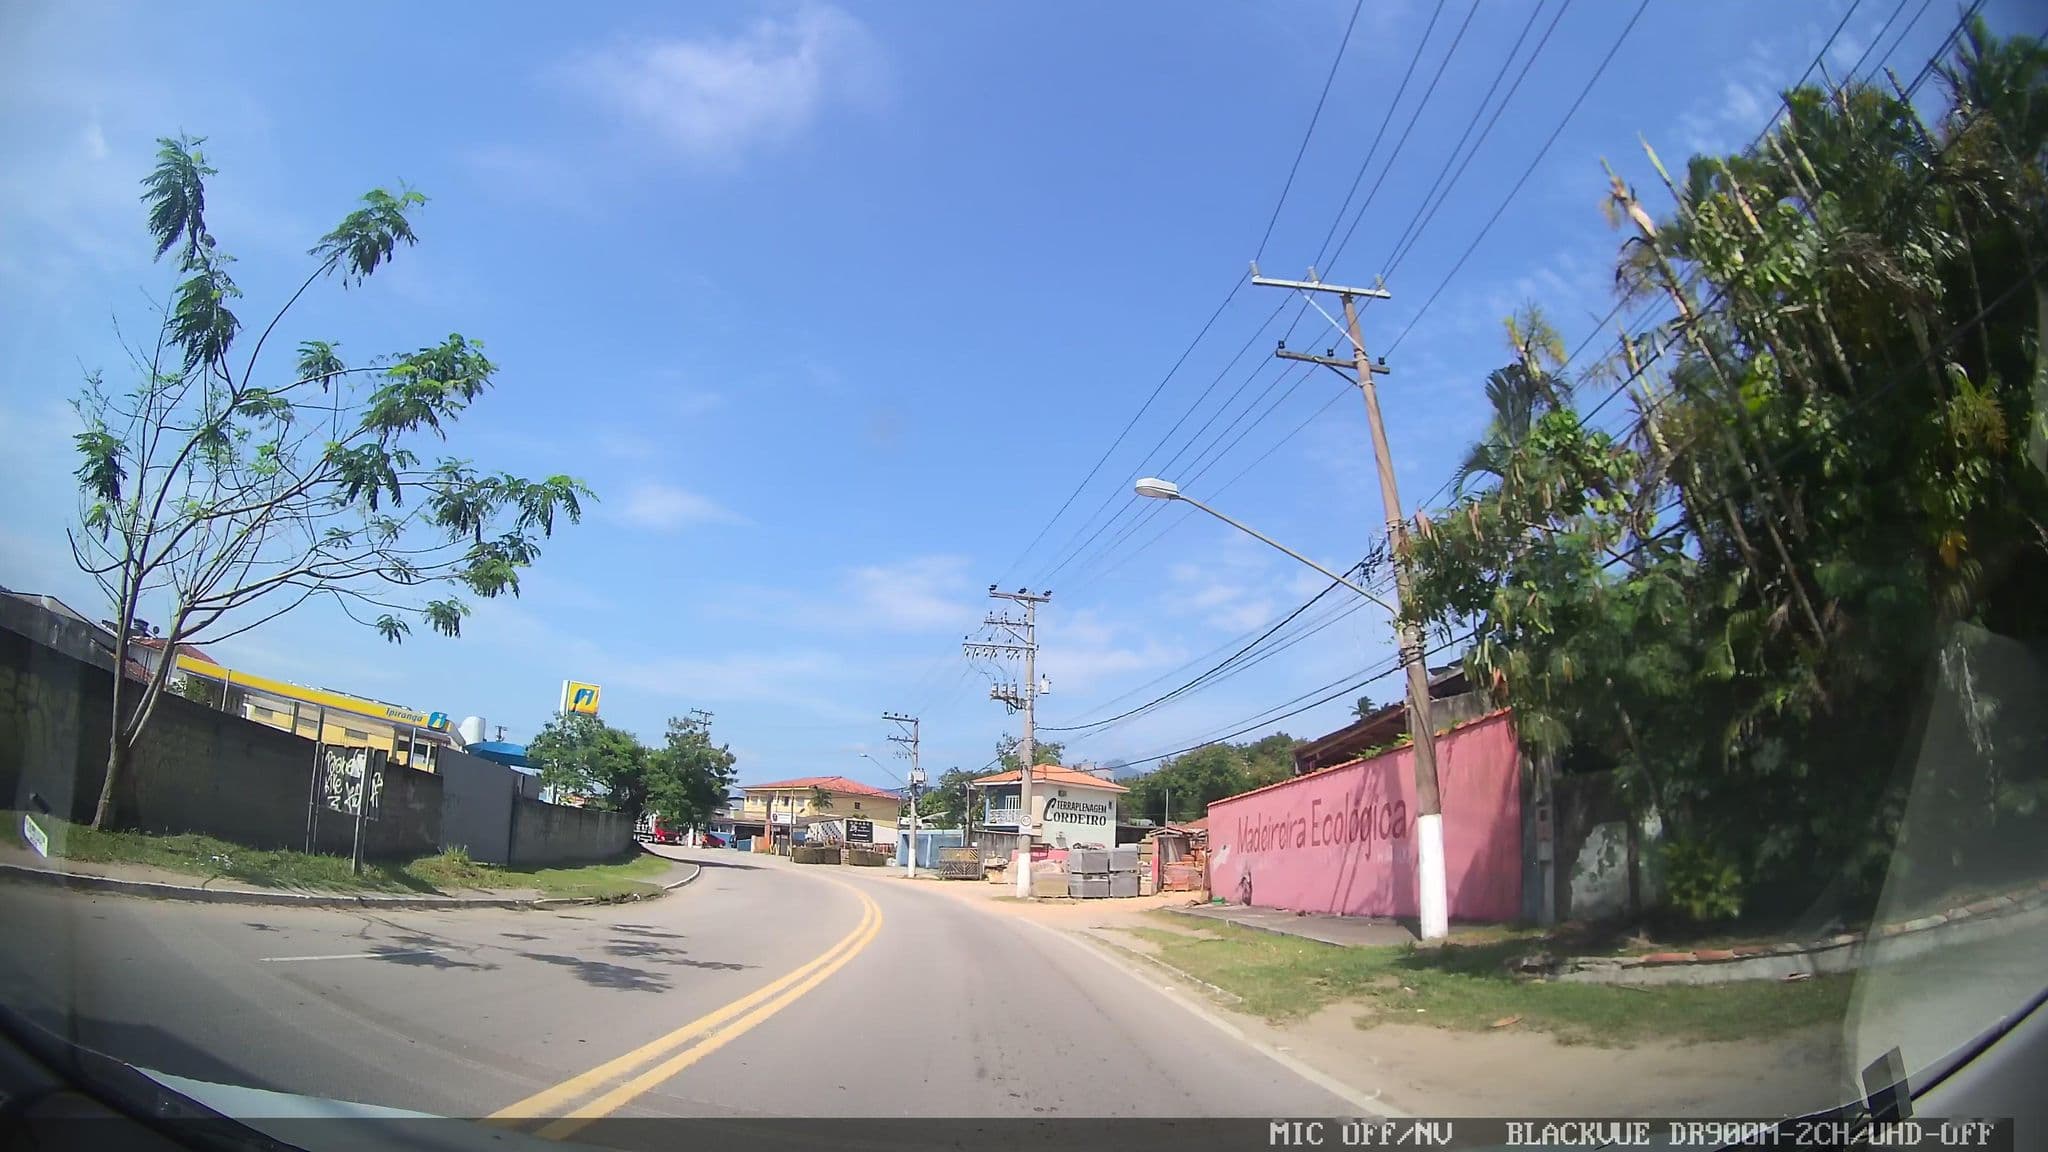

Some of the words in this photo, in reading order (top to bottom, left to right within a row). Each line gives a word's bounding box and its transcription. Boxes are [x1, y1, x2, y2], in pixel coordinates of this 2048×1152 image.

[386, 707, 423, 722] Ipiranga
[1043, 797, 1107, 827] CORDEIRO
[1057, 800, 1107, 814] TERRAPLENAGEM
[1237, 812, 1306, 854] Madeireira
